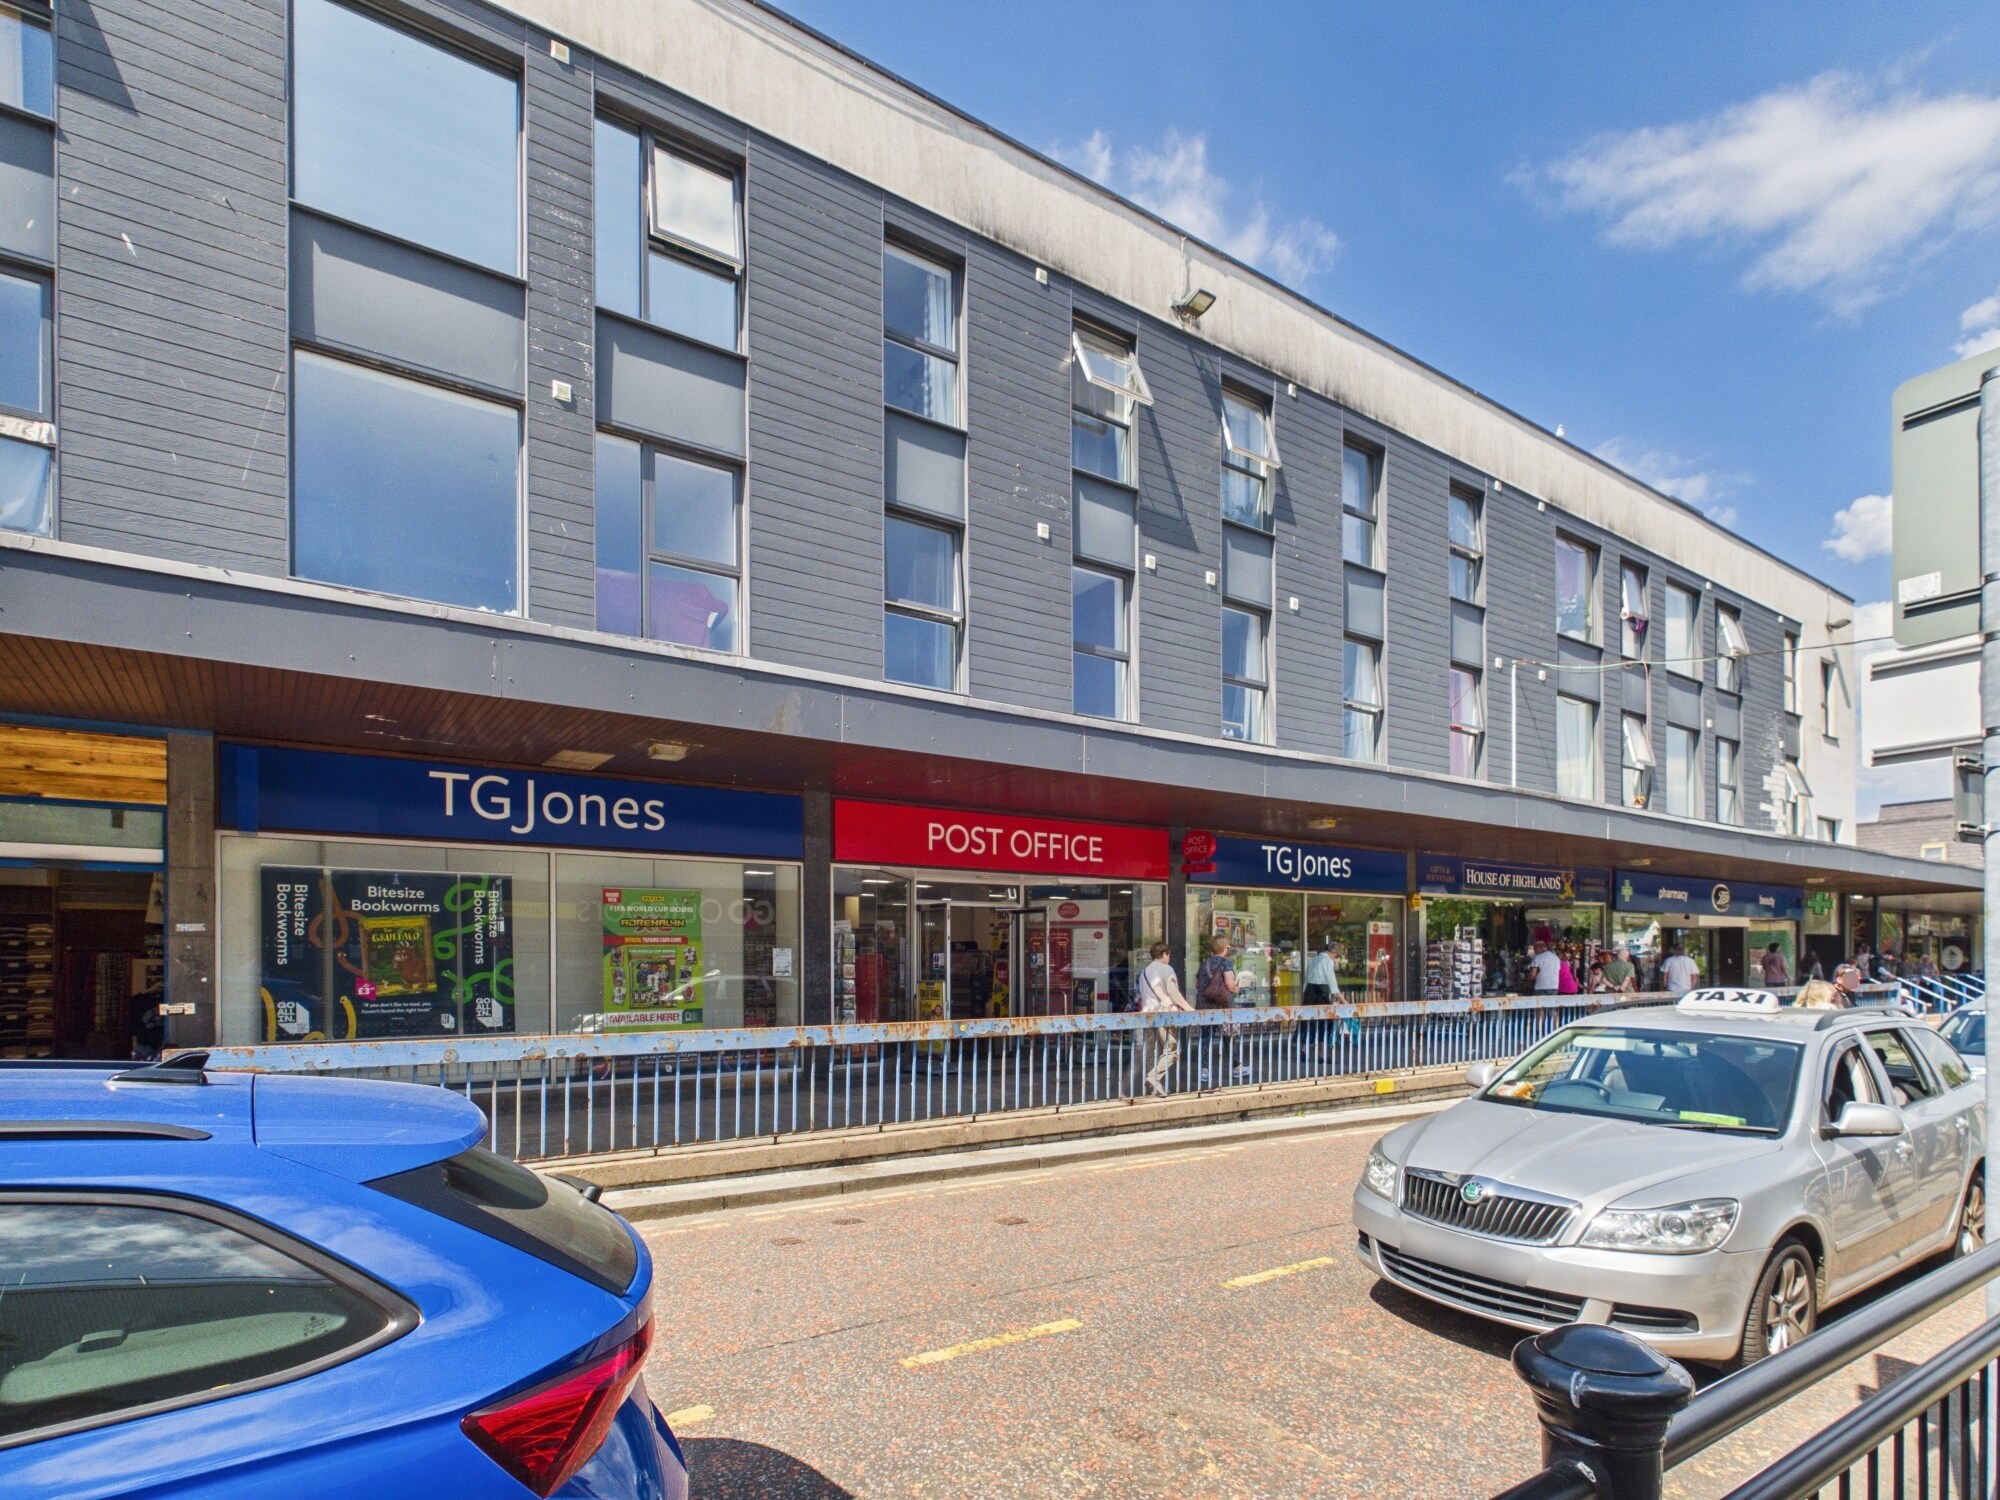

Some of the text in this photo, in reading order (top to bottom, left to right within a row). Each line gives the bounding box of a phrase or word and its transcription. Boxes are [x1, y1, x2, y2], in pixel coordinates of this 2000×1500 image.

[928, 822, 1104, 863] POST OFFICE
[1188, 836, 1206, 845] POST
[1184, 844, 1208, 855] OFFICE
[1466, 869, 1498, 886] HOUSE
[1499, 873, 1511, 887] OF
[1512, 875, 1561, 890] HIGHLANDS
[368, 886, 425, 899] Bitesize
[1658, 887, 1688, 902] pharmacy
[294, 884, 308, 936] Bitesize
[351, 899, 440, 913] Bookworms
[487, 890, 498, 938] Bitesize
[276, 884, 291, 966] Bookworms
[473, 890, 485, 965] Bookworms
[620, 918, 685, 927] ADRENALYN
[371, 930, 421, 942] GRUFFALO
[1694, 991, 1767, 1004] TAXI
[609, 1013, 680, 1023] AVAILABLE HERE!
